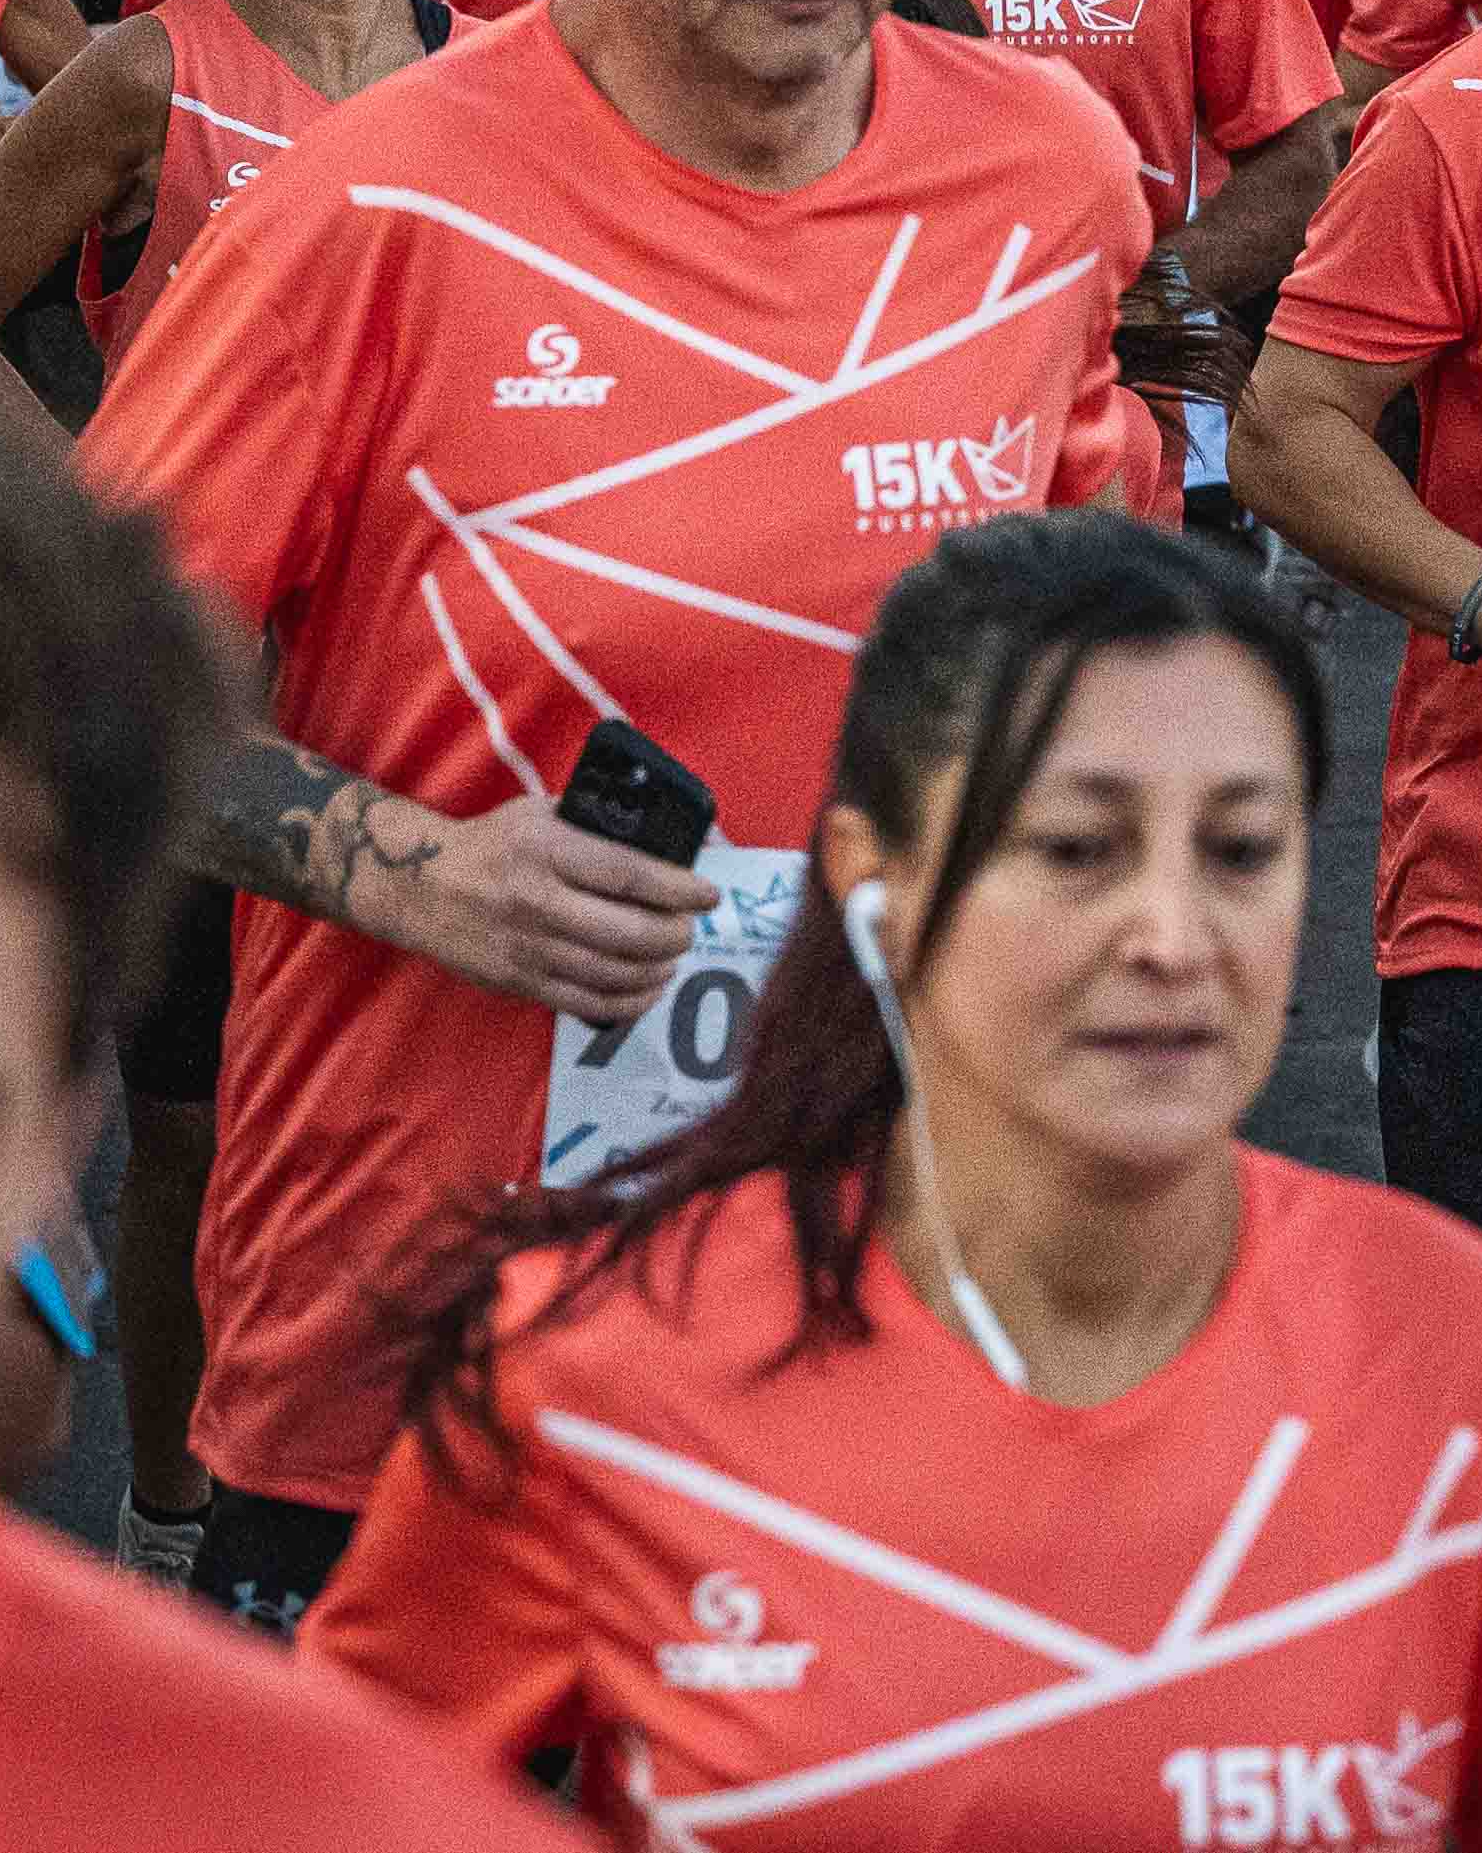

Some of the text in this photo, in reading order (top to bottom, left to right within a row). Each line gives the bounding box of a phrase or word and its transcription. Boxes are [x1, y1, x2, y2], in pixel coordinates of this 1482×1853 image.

[1076, 34, 1135, 46] NORTE
[841, 439, 967, 512] 15K
[1161, 1744, 1352, 1849] 15K
